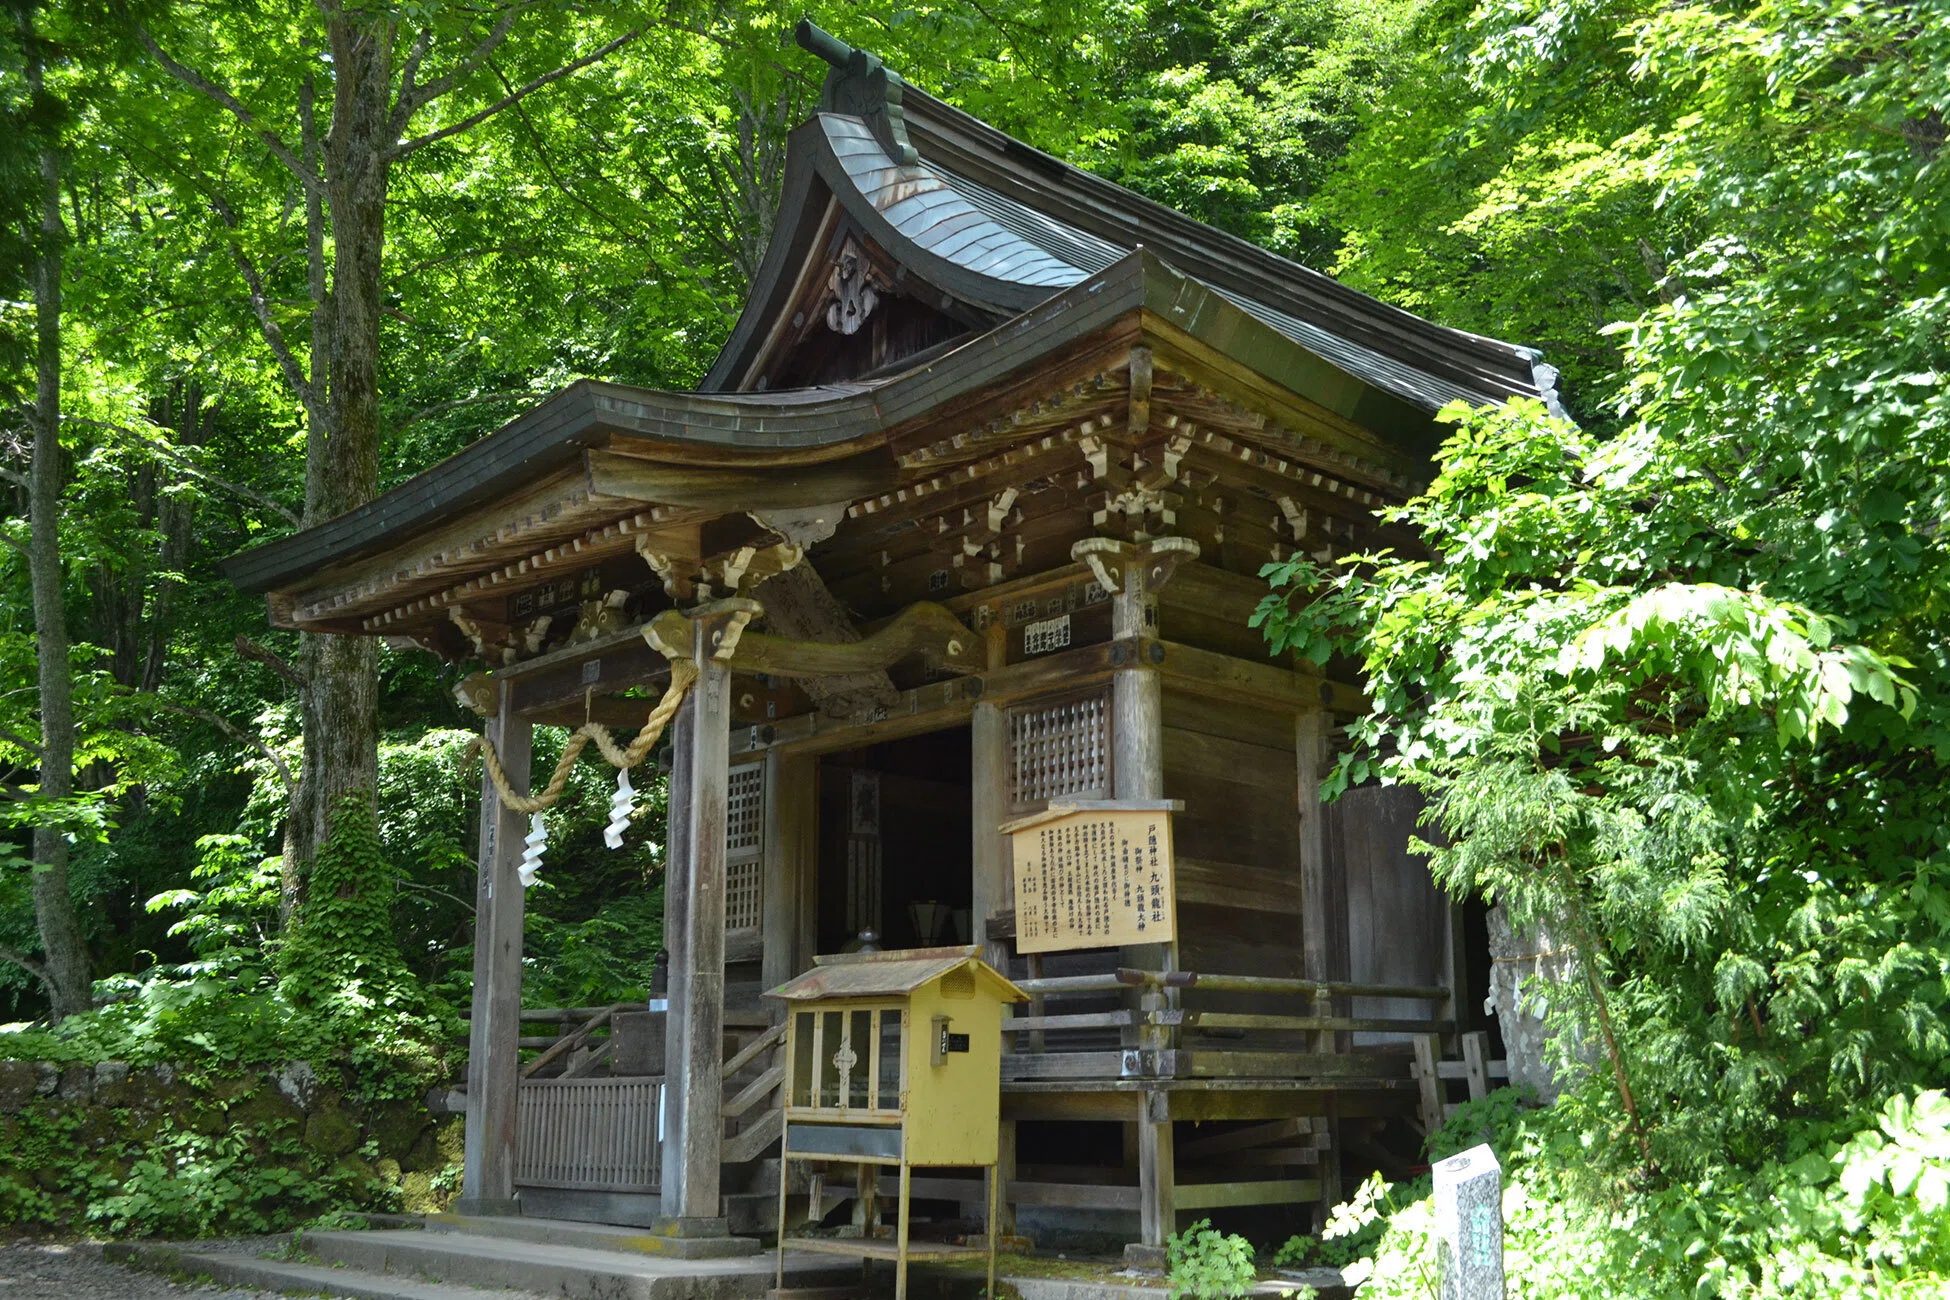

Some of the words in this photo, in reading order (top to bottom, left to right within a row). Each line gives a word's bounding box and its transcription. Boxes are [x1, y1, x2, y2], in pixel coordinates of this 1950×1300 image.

[1135, 848, 1143, 873] 御祭神
[1148, 824, 1159, 866] 戸隠神社
[1136, 885, 1145, 931] 九頭龍大神
[1150, 873, 1161, 922] 九頭龍社
